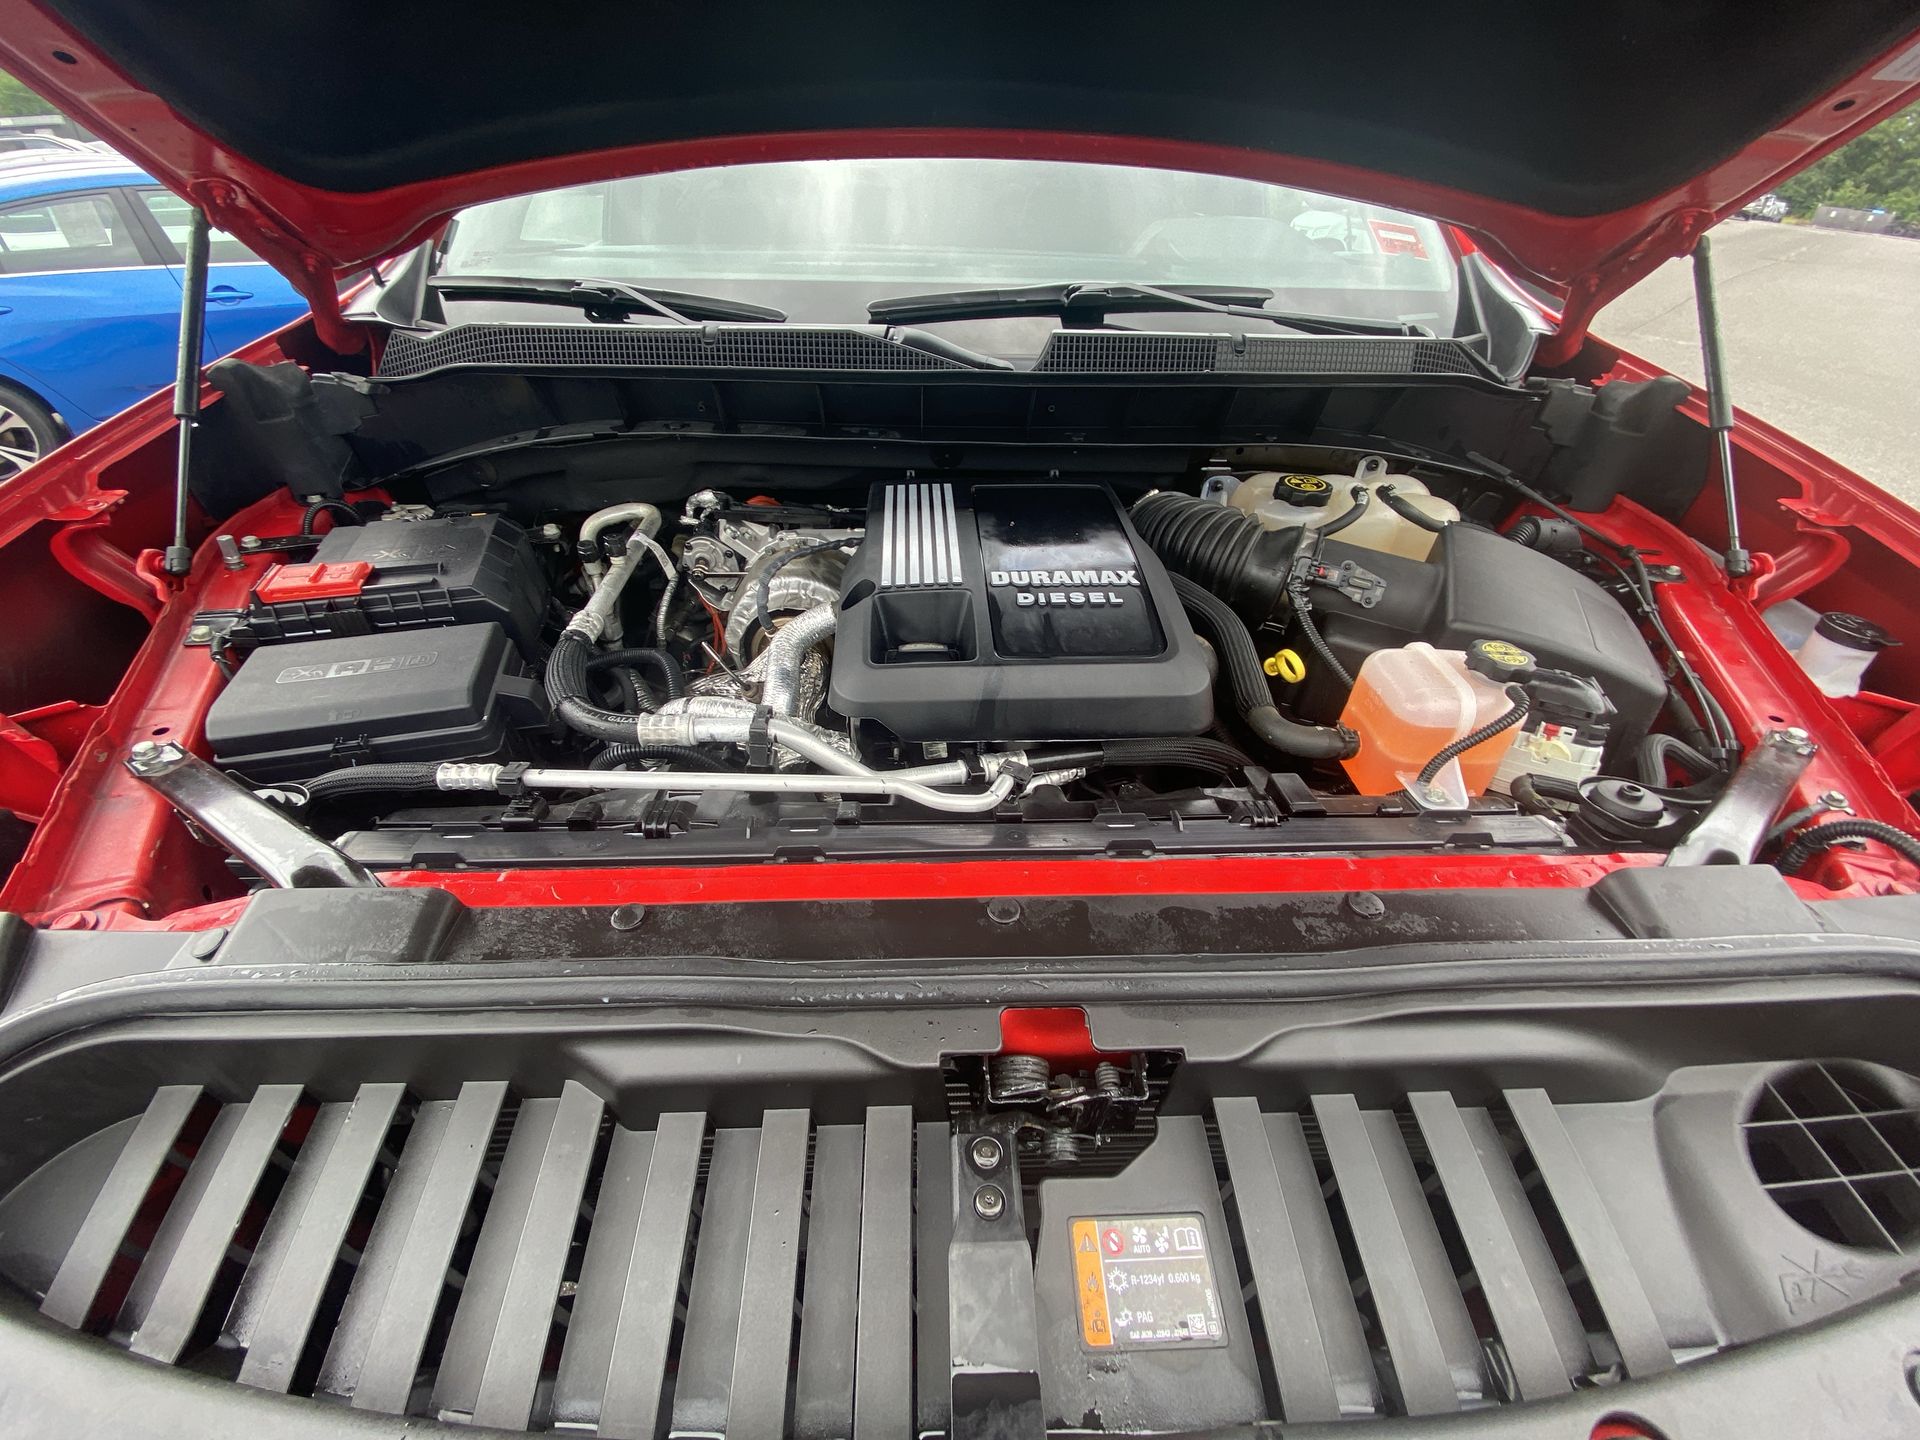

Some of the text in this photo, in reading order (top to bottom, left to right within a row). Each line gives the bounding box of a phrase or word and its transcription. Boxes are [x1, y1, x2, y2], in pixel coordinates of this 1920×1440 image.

[990, 570, 1141, 587] DURAMAX
[1016, 592, 1124, 607] DIESEL
[1133, 1244, 1151, 1254] AUTO
[1168, 1272, 1189, 1283] 0.600
[1190, 1271, 1201, 1284] kg
[1137, 1311, 1154, 1322] PAG
